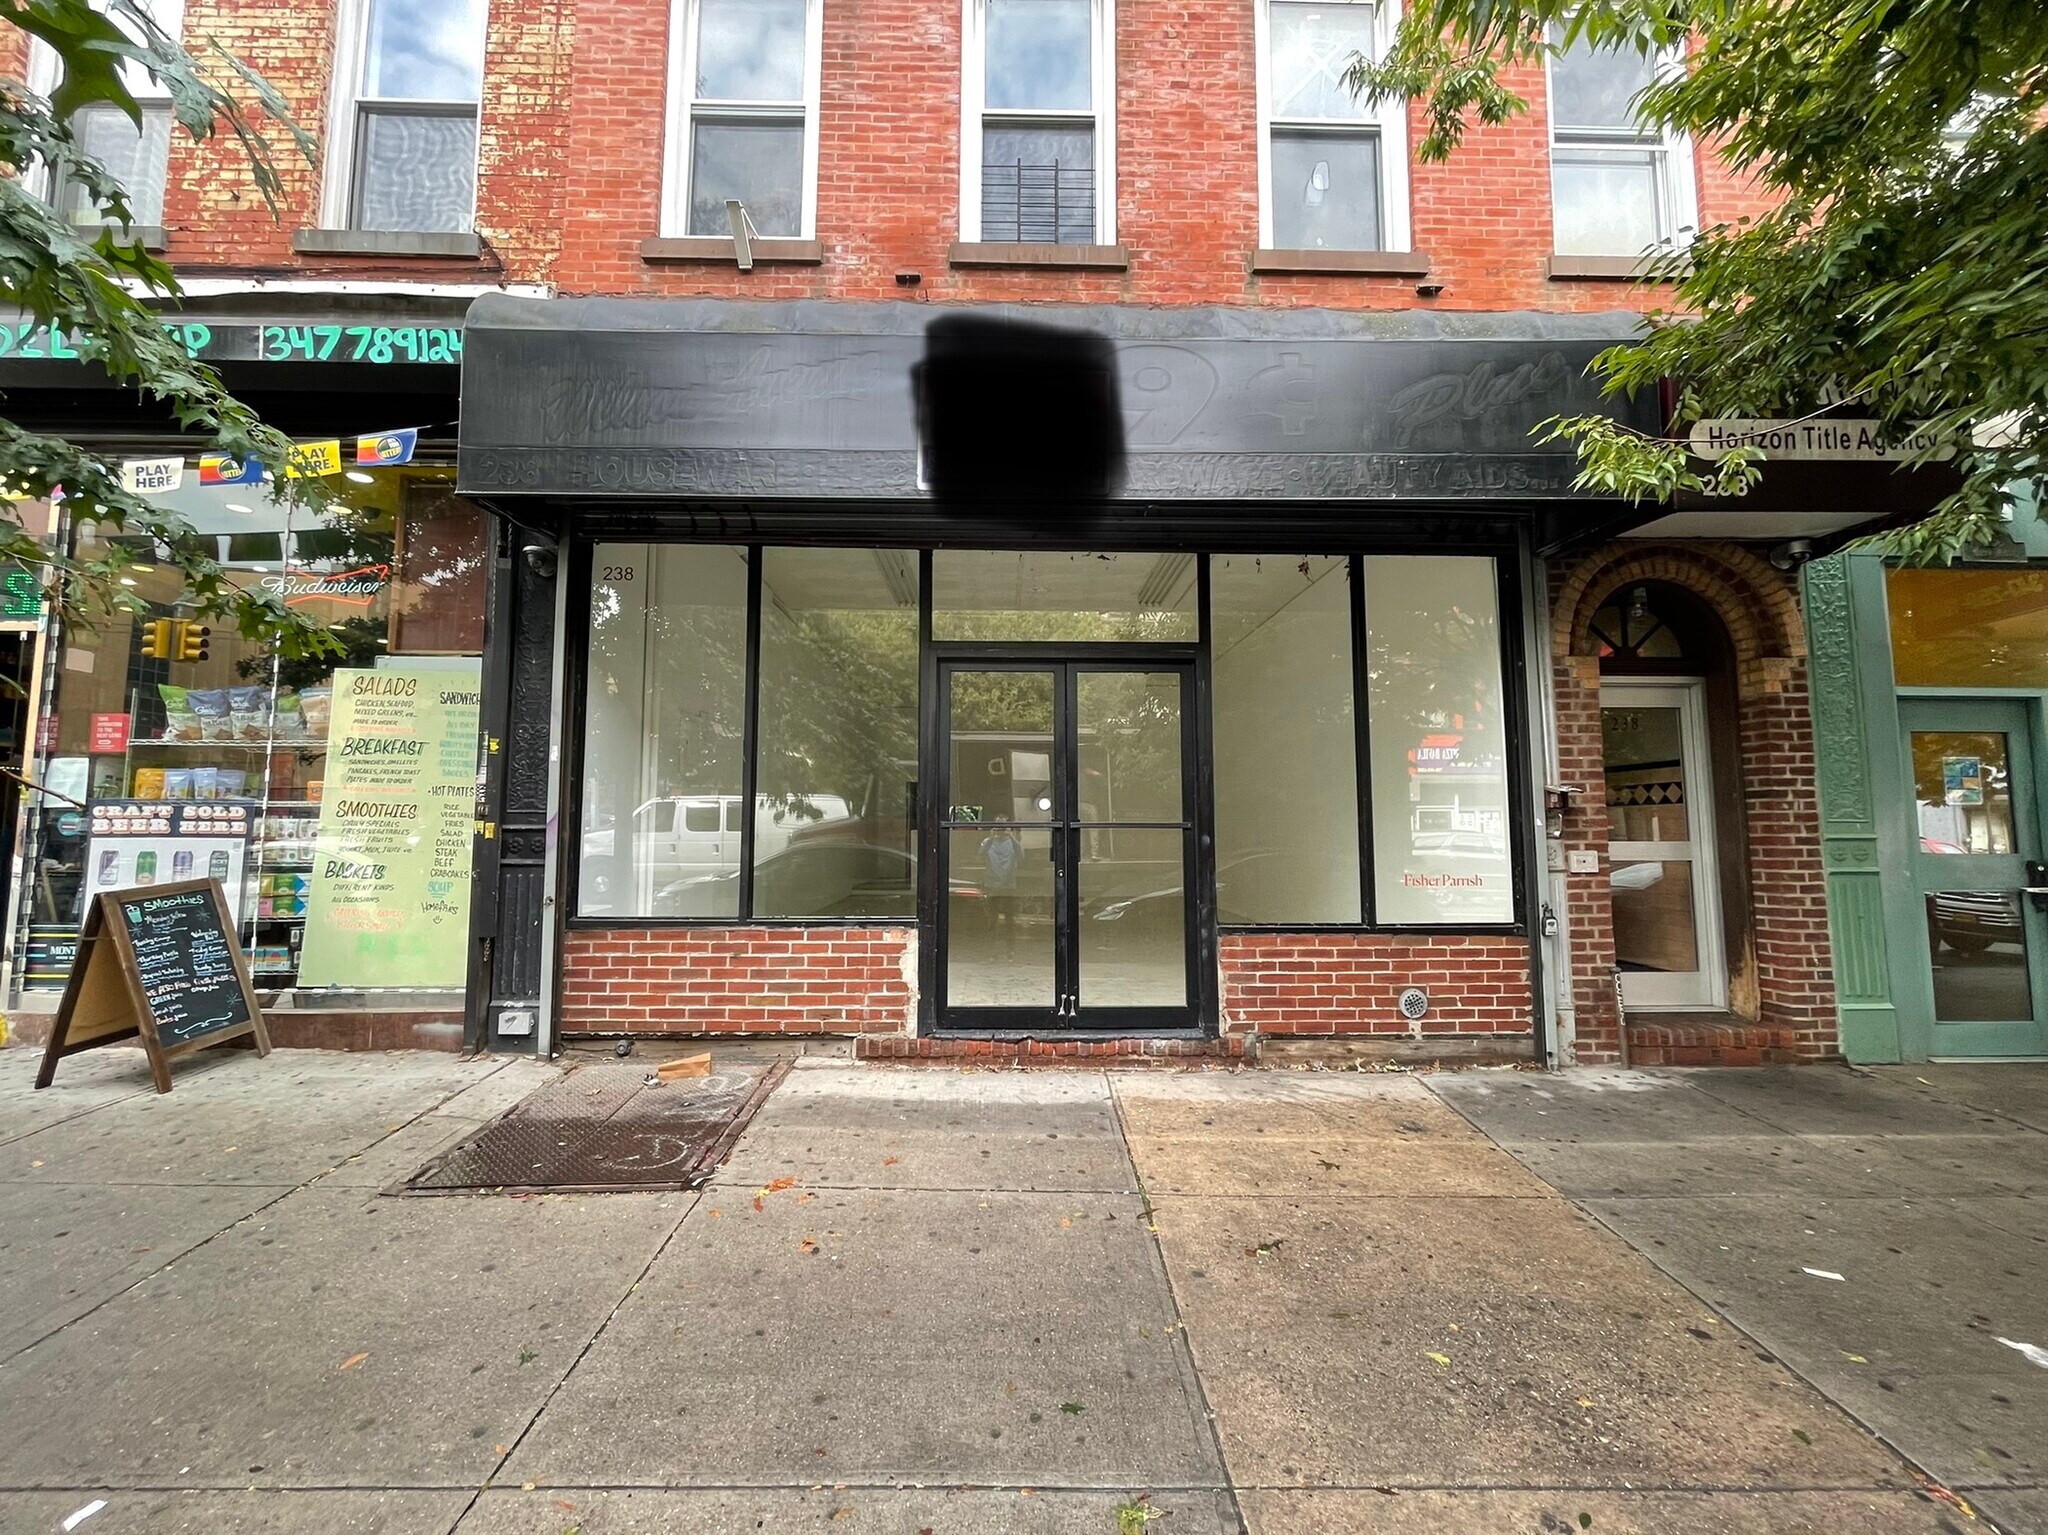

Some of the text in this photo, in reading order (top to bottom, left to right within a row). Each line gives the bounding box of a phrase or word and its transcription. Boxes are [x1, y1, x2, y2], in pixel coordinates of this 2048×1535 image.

[1709, 426, 1796, 450] Horizon
[1802, 426, 1850, 450] Title
[136, 465, 171, 477] PLAY
[136, 475, 176, 488] HERE.
[603, 566, 634, 581] 238
[261, 576, 385, 597] Budweiser
[352, 675, 417, 697] SALADS
[340, 736, 430, 757] BREAKFAST
[432, 786, 474, 797] HOT PLATES
[92, 805, 246, 820] CRAFT SOLD
[336, 800, 418, 819] SMOOTHIES
[443, 803, 460, 811] RICE
[91, 819, 248, 835] BEER HERE
[365, 820, 400, 828] SPECIALS
[445, 820, 464, 828] FRIES
[368, 828, 410, 836] VEGETABLES
[440, 829, 463, 837] SALAD
[436, 839, 466, 847] CHICKEN
[435, 849, 458, 857] STEAK
[434, 858, 453, 867] BEEF
[324, 861, 387, 880] BASKETS
[430, 870, 469, 879] CRABCAKES
[1404, 874, 1483, 887] Fisher Parrish
[373, 884, 394, 892] KINDS
